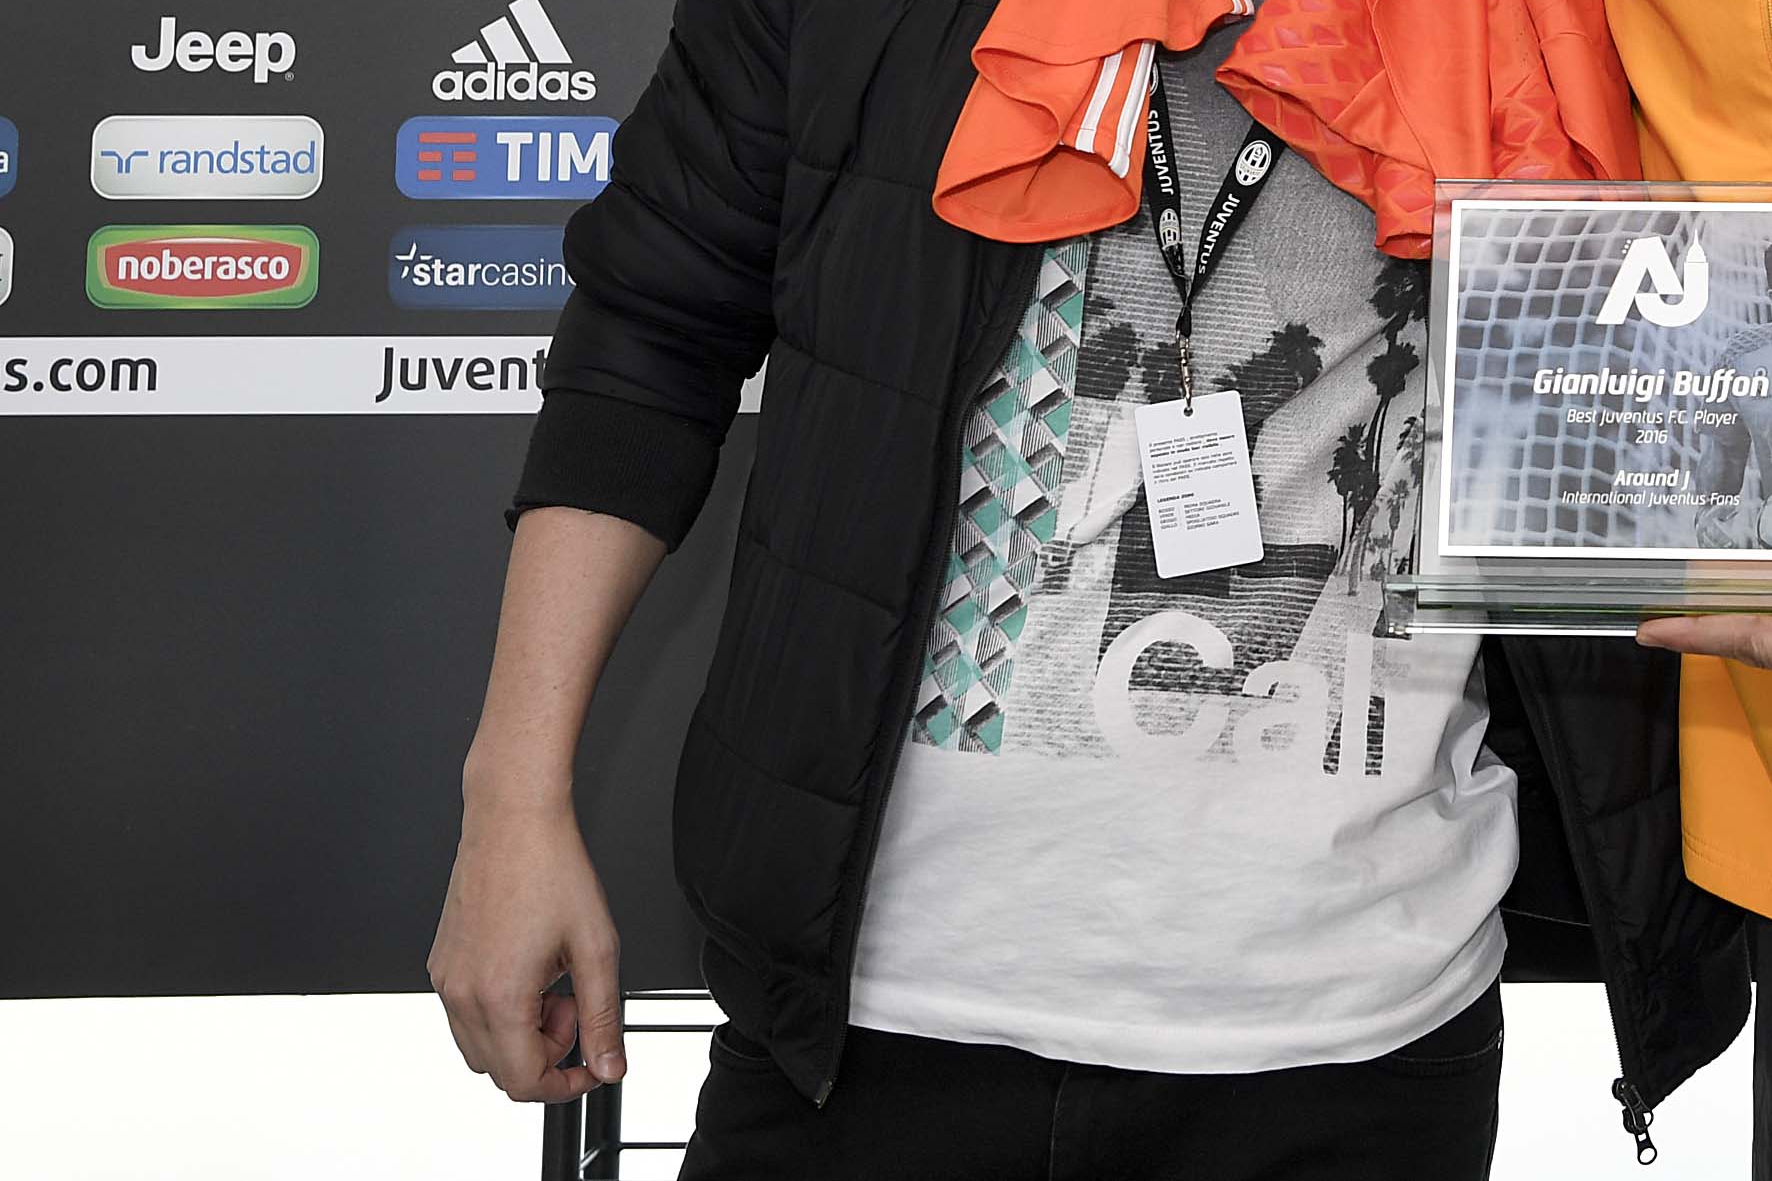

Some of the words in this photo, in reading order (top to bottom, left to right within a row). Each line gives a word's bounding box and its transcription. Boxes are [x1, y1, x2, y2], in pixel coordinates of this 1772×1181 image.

[131, 16, 297, 84] Jeep
[432, 61, 597, 102] adidas
[158, 139, 316, 175] randstad
[496, 130, 611, 182] TIM
[1148, 109, 1174, 196] JUVENTUS
[1199, 192, 1241, 275] JUVENTUS
[117, 248, 290, 282] noberasco
[412, 257, 578, 287] starcasin
[1532, 367, 1666, 403] Gianluigi
[1672, 368, 1770, 404] Buffon
[1566, 408, 1597, 424] Best
[1599, 409, 1663, 427] Juventus
[1667, 410, 1690, 425] F.C.
[1694, 409, 1739, 428] Player
[1635, 429, 1668, 445] 2016
[1613, 469, 1680, 487] Around
[1681, 470, 1691, 491] J
[1561, 490, 1646, 506] International
[1648, 491, 1706, 508] Juventus
[1709, 492, 1741, 507] Fans
